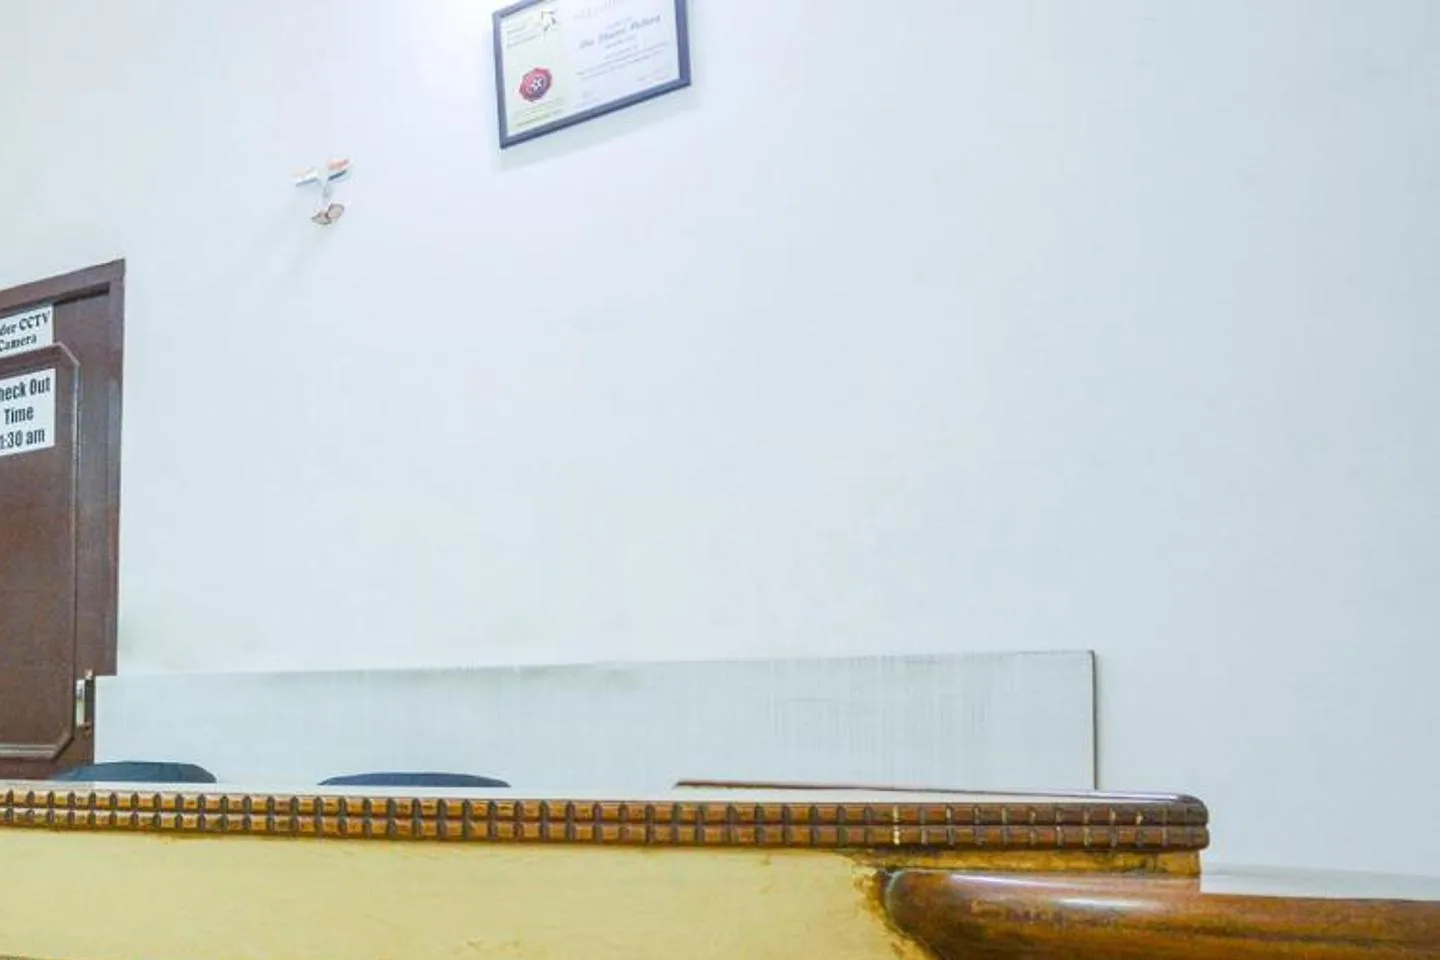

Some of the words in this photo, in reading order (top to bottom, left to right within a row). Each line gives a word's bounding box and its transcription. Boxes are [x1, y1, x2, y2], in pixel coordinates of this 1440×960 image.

[18, 312, 49, 331] CCTV
[29, 376, 51, 394] Out
[4, 406, 34, 424] Time
[26, 428, 45, 443] am
